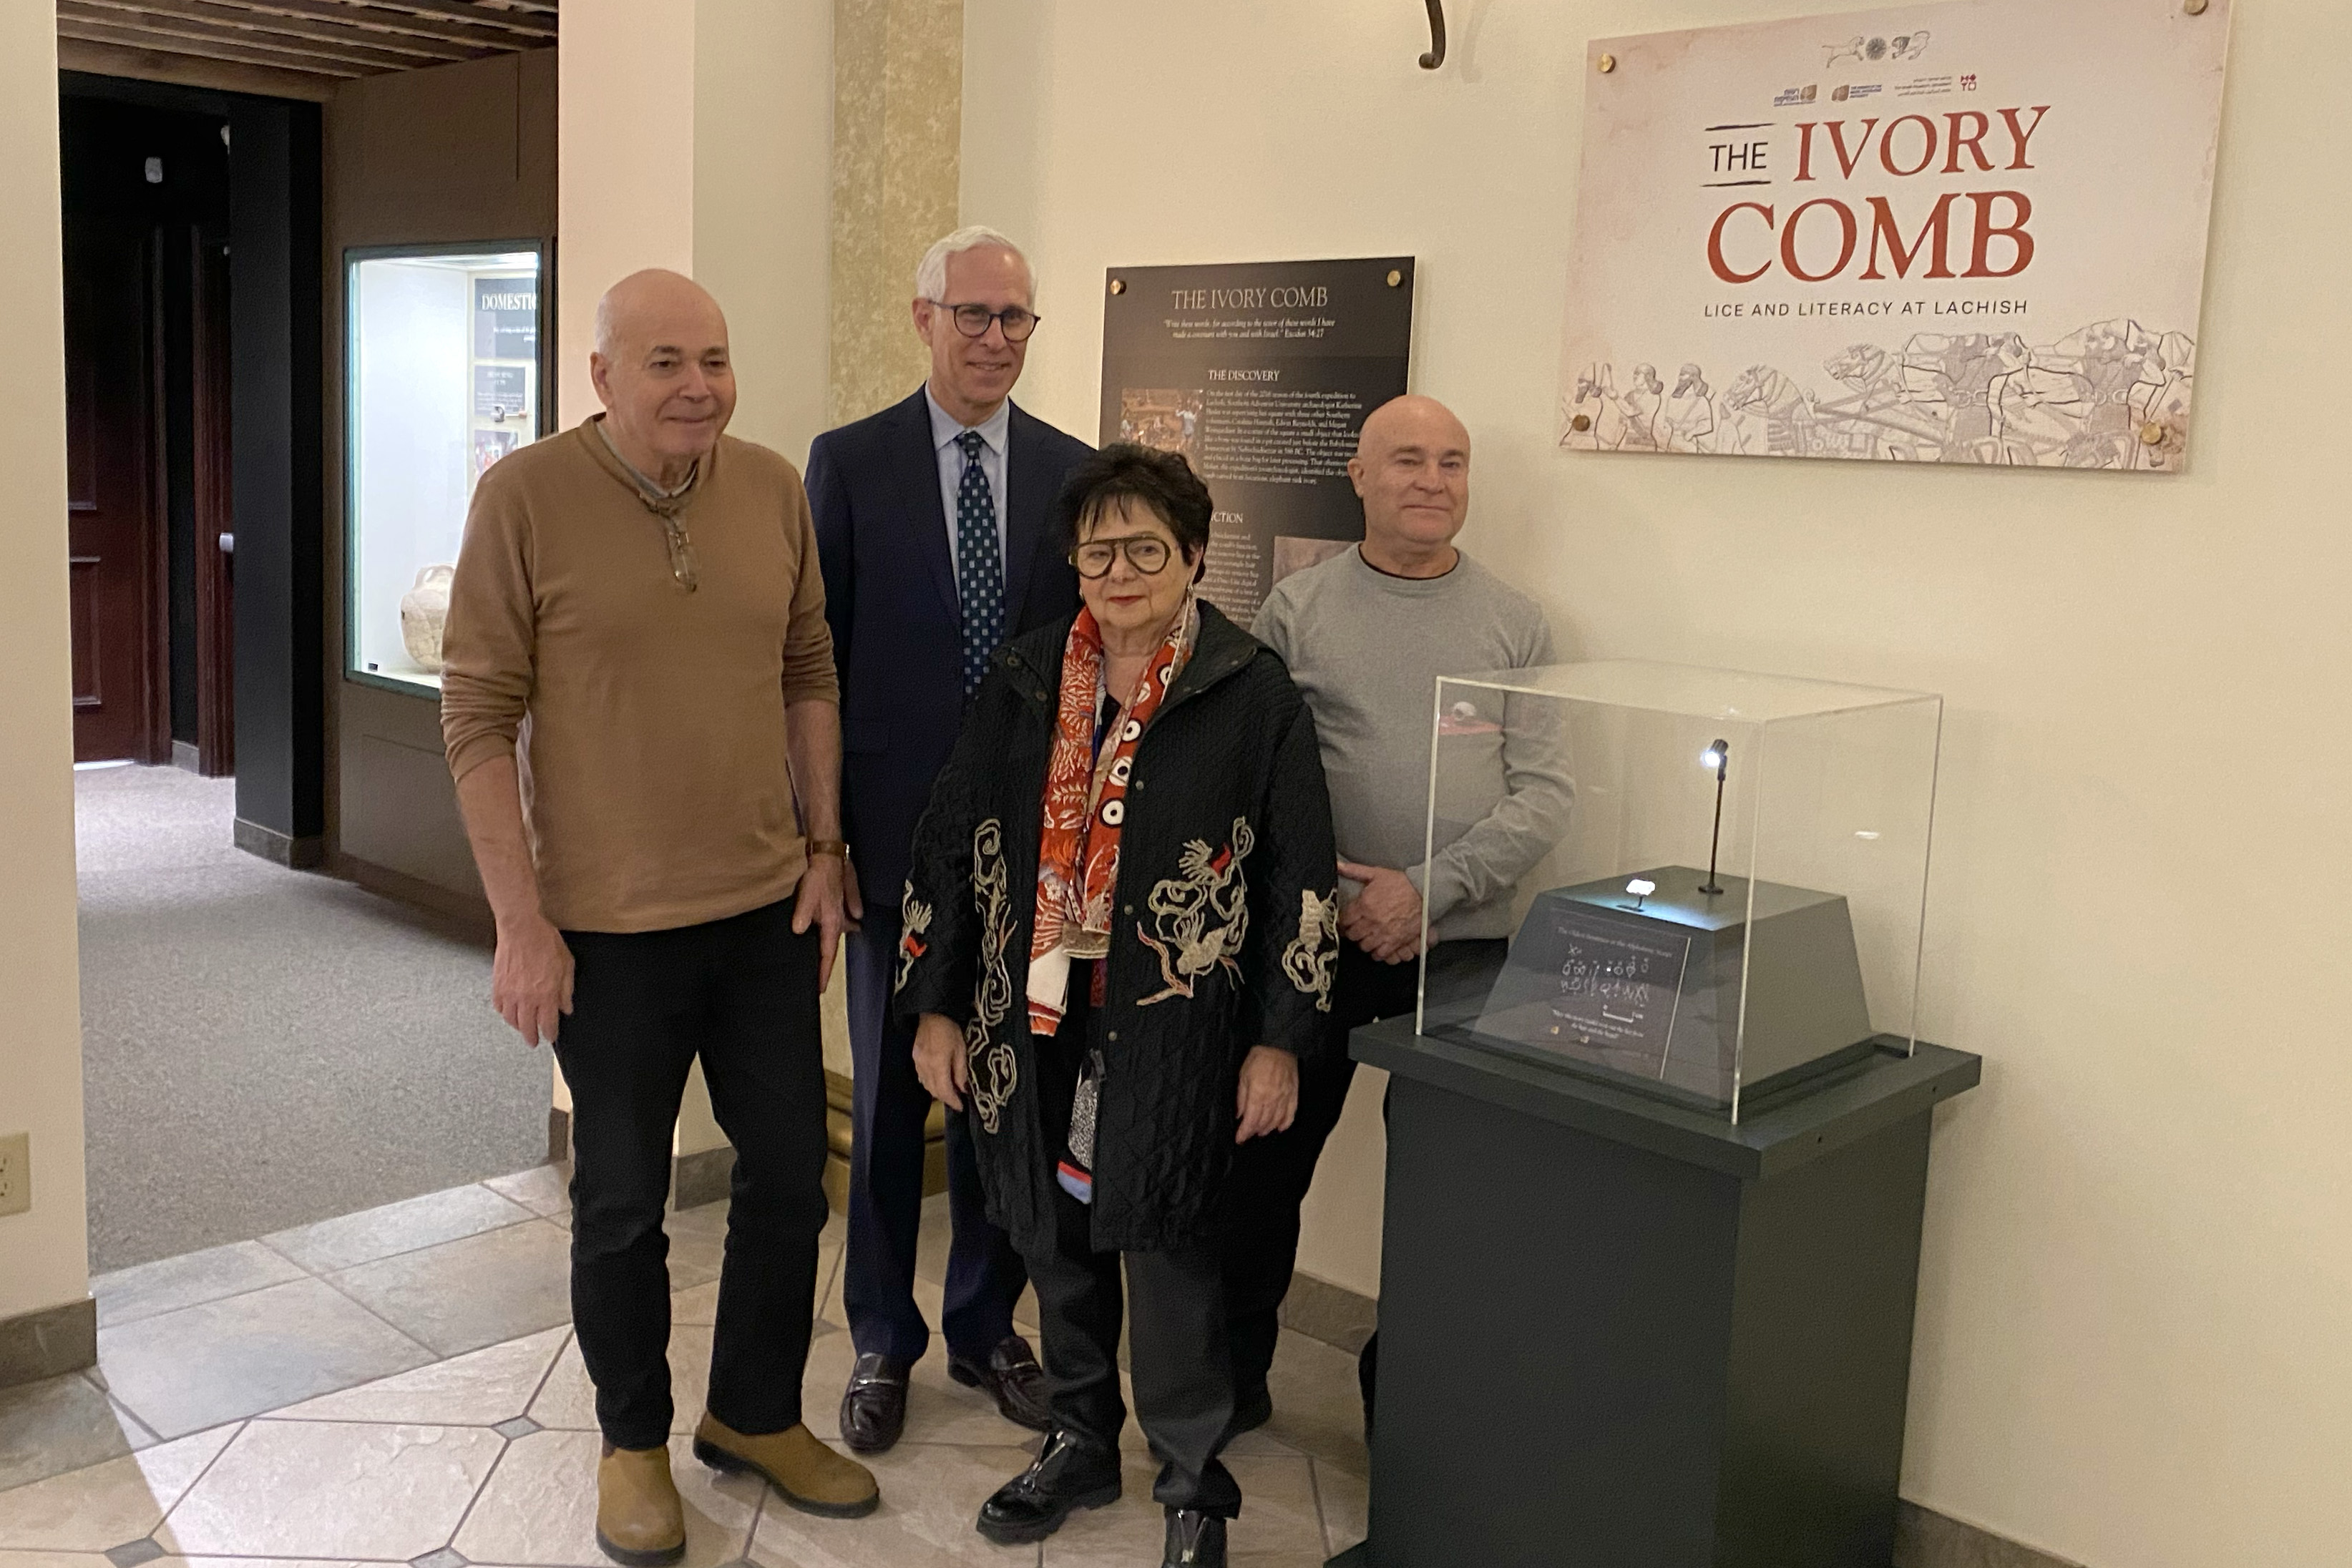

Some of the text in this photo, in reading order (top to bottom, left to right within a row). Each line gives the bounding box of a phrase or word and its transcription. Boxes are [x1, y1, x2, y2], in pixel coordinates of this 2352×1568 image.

[1708, 105, 2051, 182] THE IVORY
[1707, 190, 2035, 284] COMB
[1171, 286, 1328, 310] THE IVORY COMB
[1704, 300, 2028, 318] LICE AND LITERACY AT LACHISH
[1208, 369, 1279, 381] THE DISCOVERY
